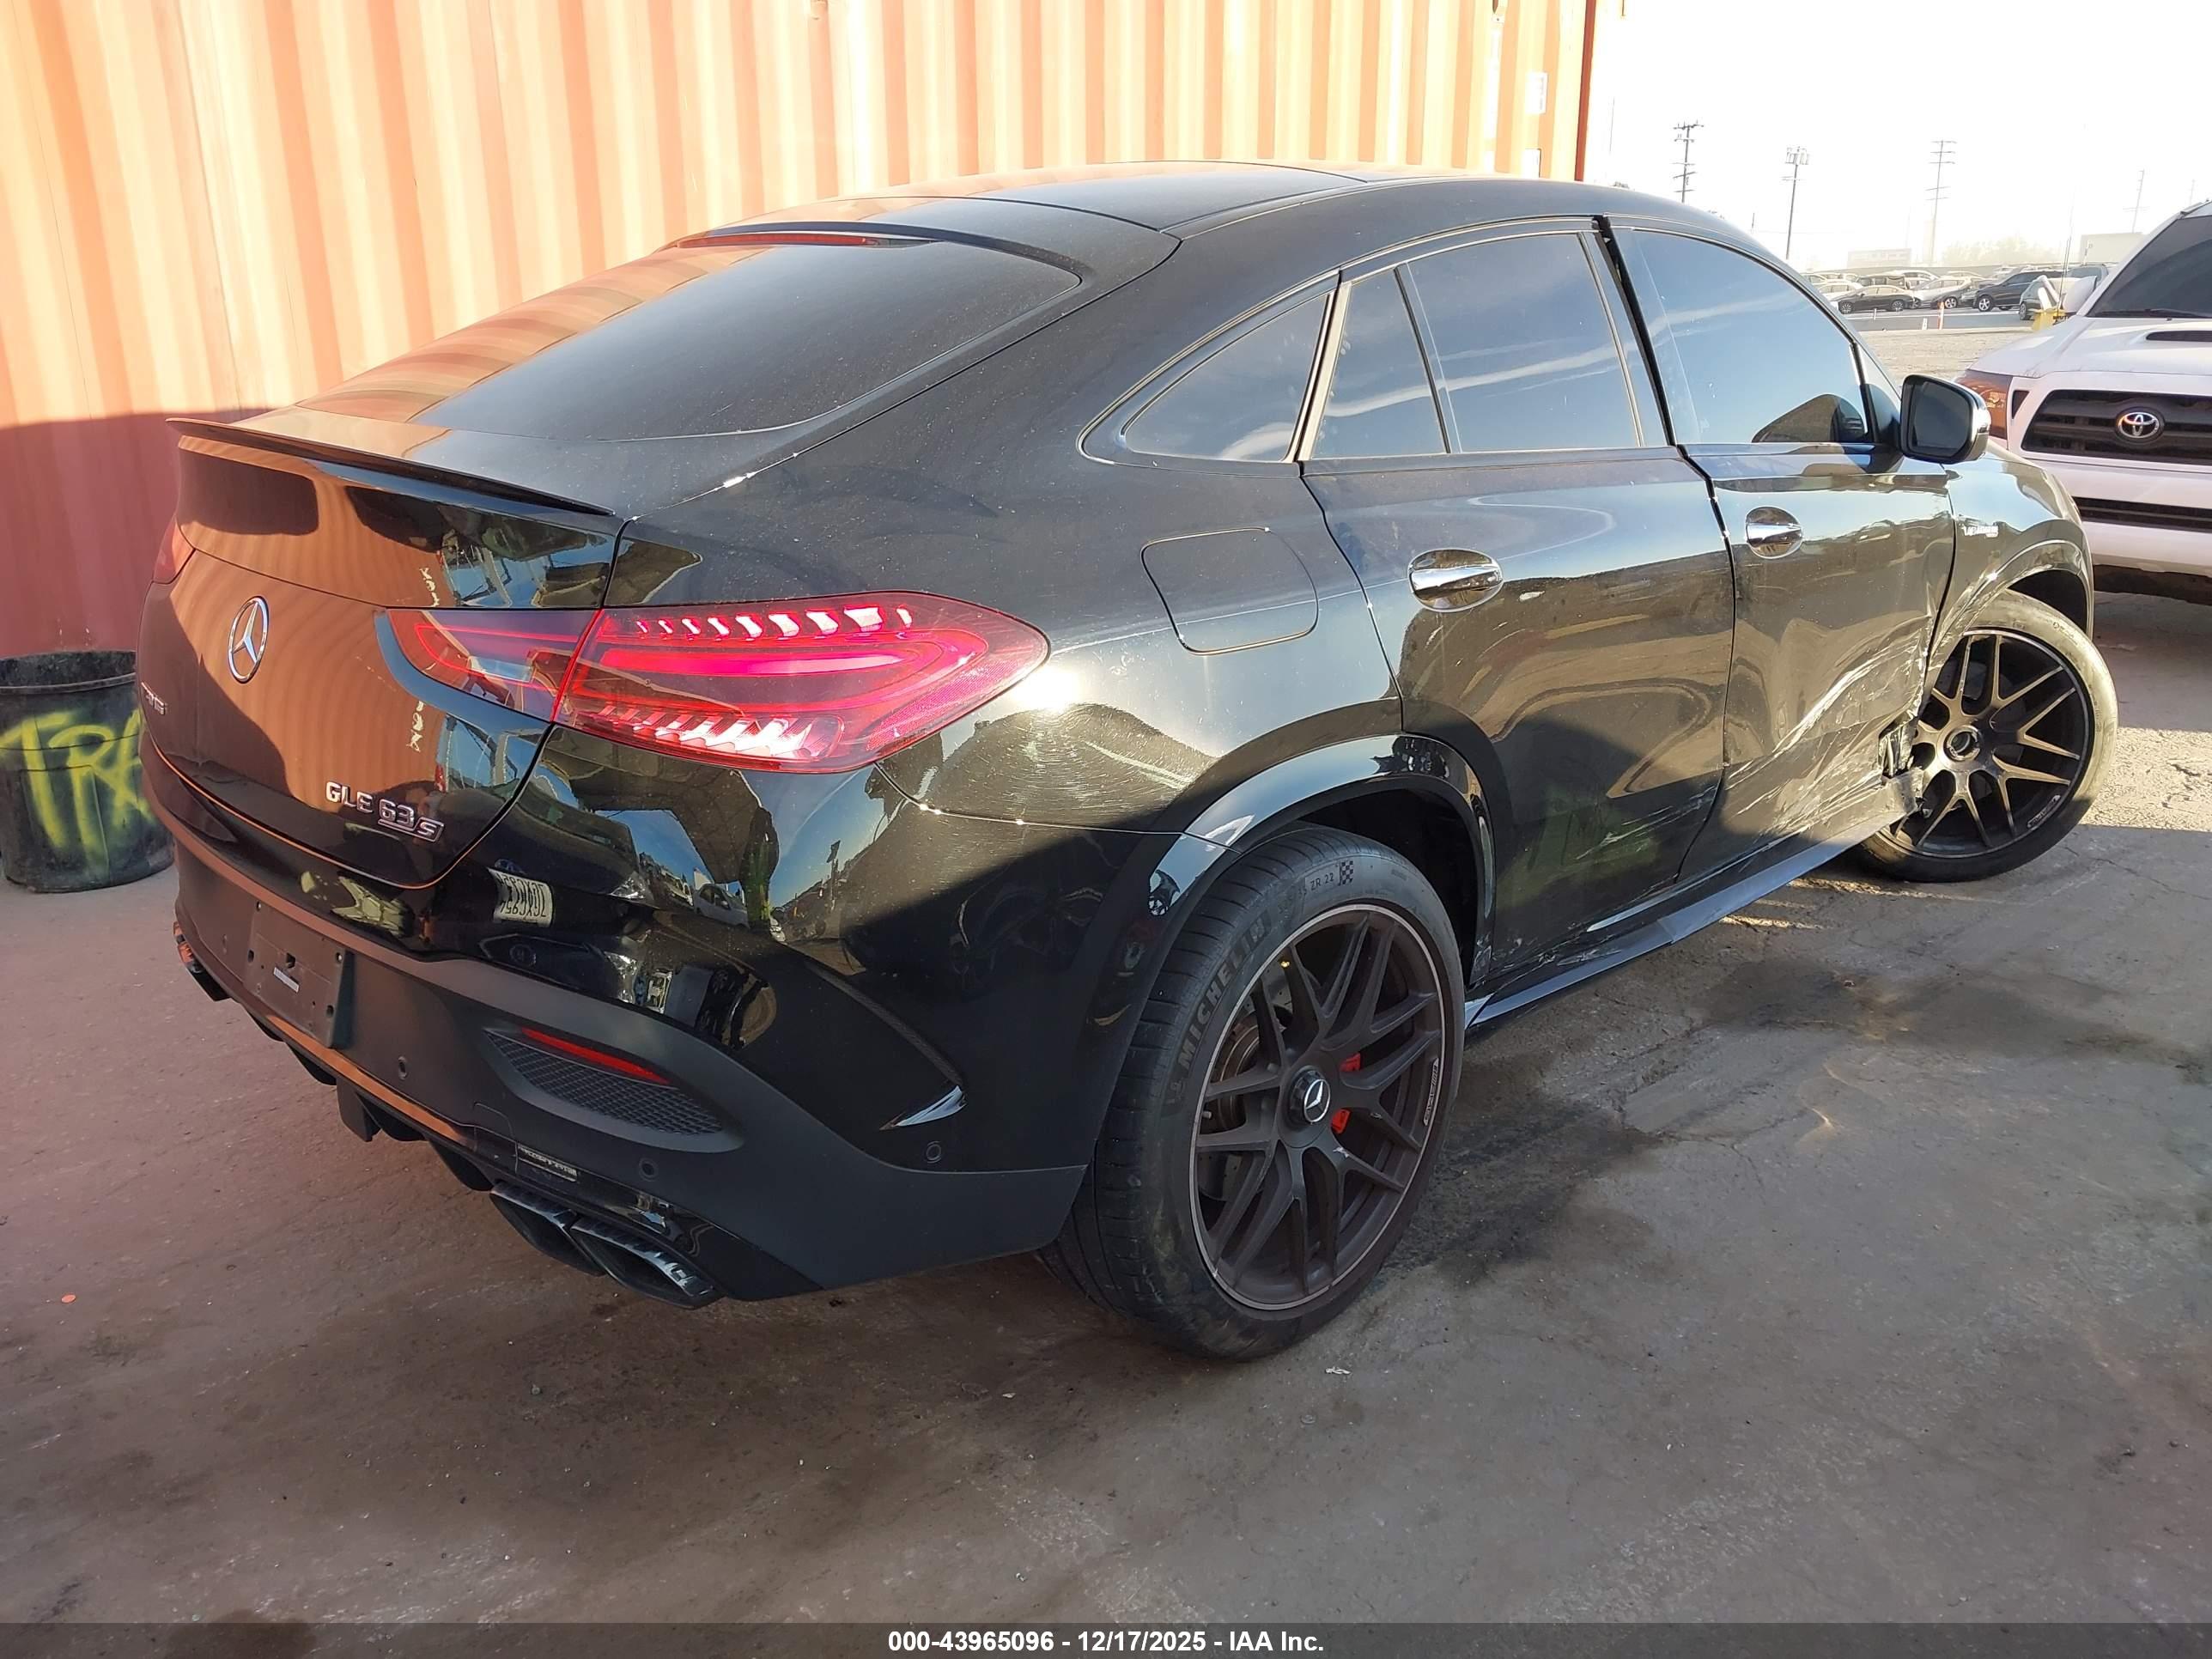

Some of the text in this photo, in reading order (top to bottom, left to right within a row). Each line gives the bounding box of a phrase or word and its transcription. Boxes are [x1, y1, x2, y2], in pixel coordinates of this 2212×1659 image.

[325, 781, 438, 836] GLE 63 S
[1310, 877, 1322, 891] ZR
[1323, 872, 1335, 885] 22
[1177, 912, 1269, 1070] MICHELIN
